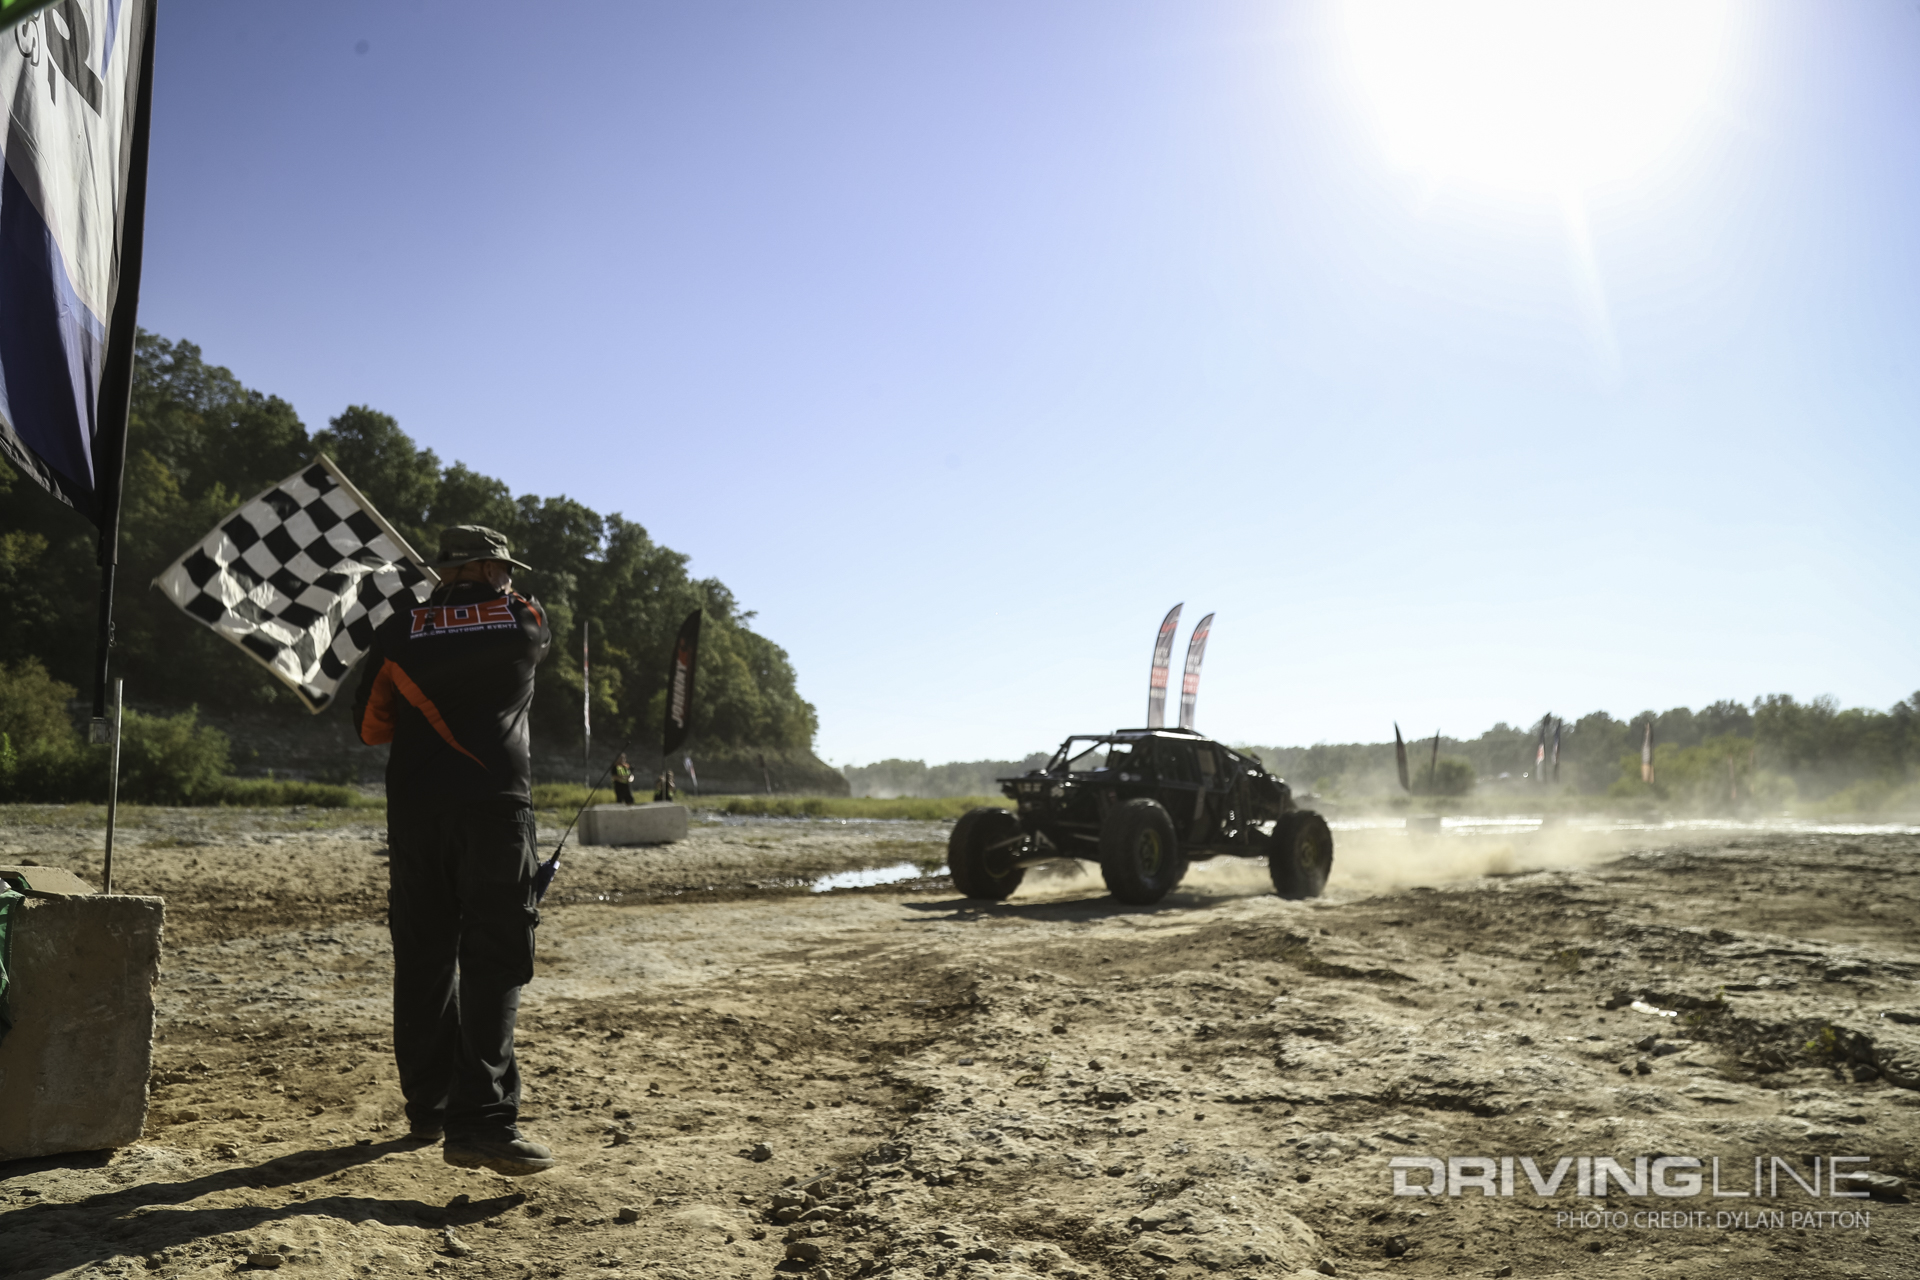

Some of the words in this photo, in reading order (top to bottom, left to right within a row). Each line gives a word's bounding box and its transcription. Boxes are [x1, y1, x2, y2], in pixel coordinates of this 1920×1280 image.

[410, 595, 516, 633] AOE
[410, 629, 446, 639] AMERCAN
[672, 659, 687, 728] JOHNNY
